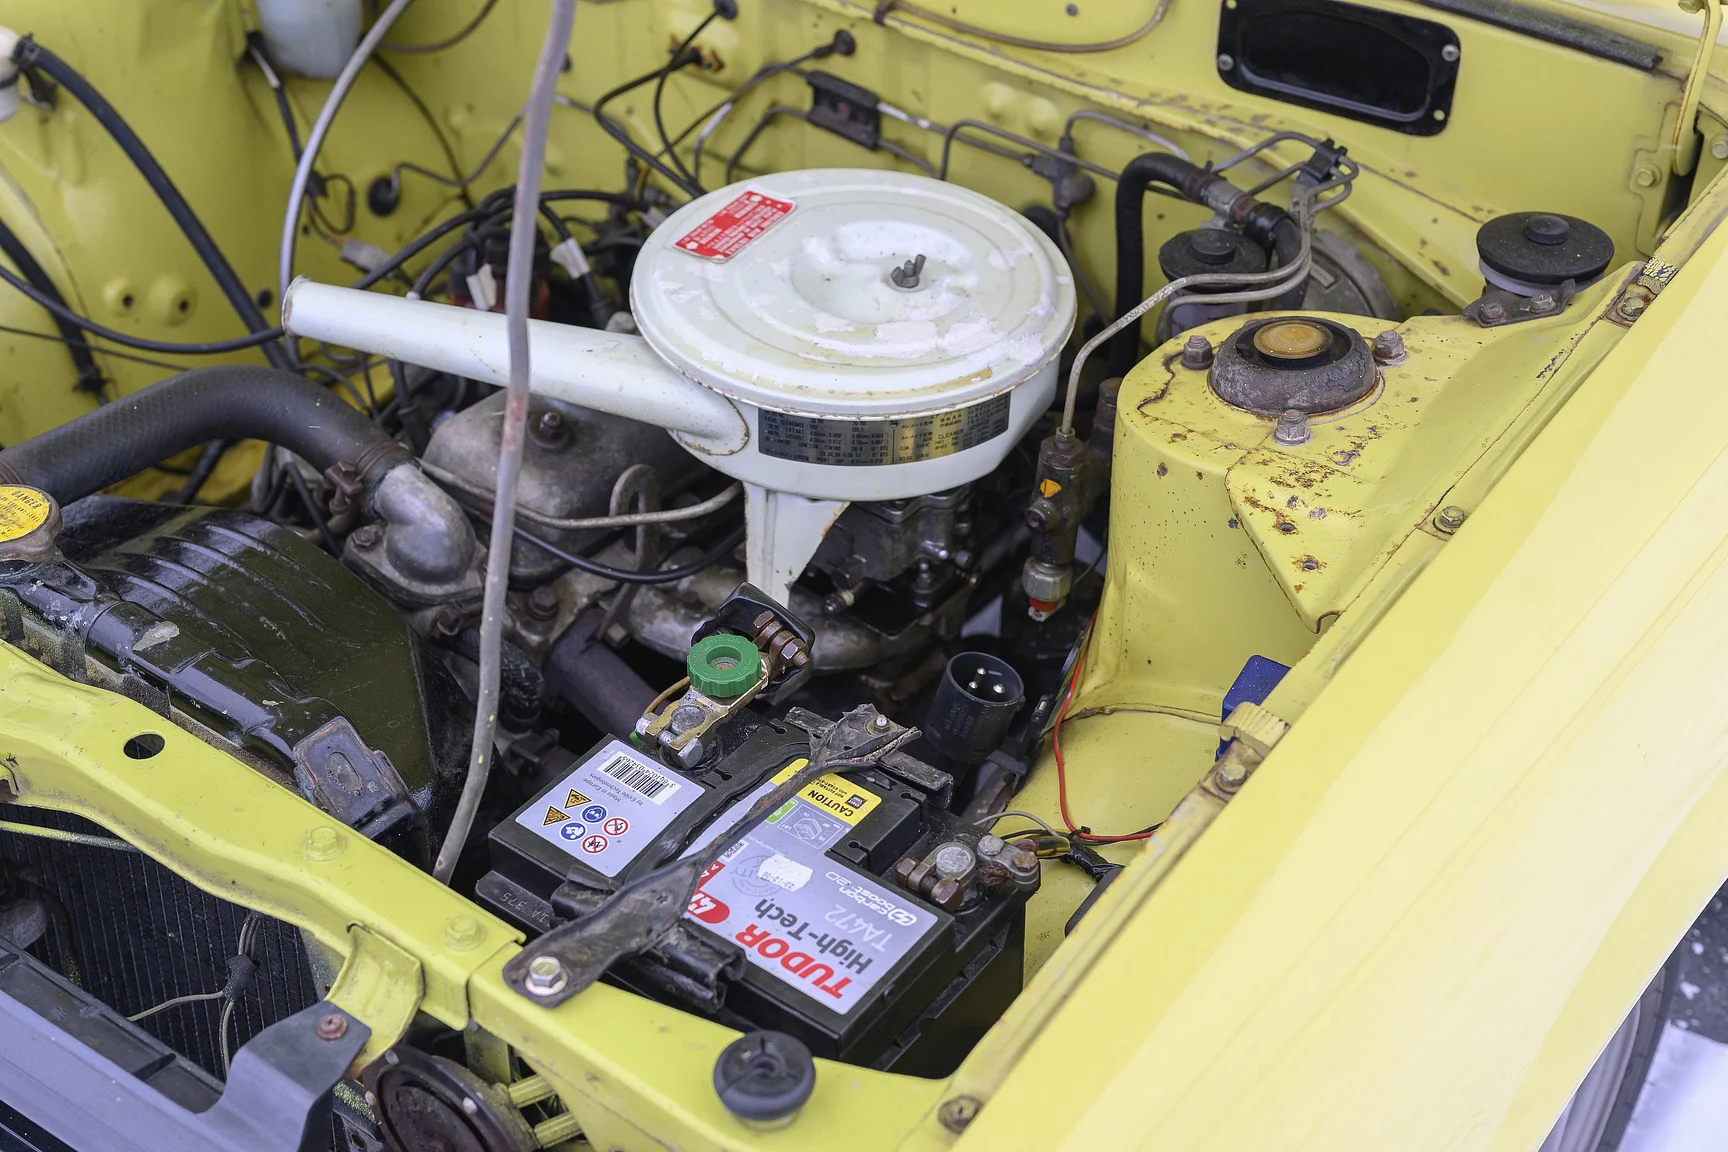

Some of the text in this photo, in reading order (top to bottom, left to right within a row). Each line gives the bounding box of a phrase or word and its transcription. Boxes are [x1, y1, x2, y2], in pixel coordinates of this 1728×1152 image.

[937, 429, 964, 440] CLEANER
[11, 490, 43, 509] DANGER
[582, 778, 602, 791] Europe
[589, 772, 622, 794] Technologies
[606, 791, 621, 803] Made
[621, 791, 637, 803] Exide
[808, 789, 855, 817] CAUTION
[499, 892, 528, 910] 375
[839, 886, 889, 915] carbon
[854, 886, 897, 911] boost
[755, 898, 874, 975] High-Tech
[824, 904, 893, 952] TA472
[735, 923, 853, 999] TUDOR
